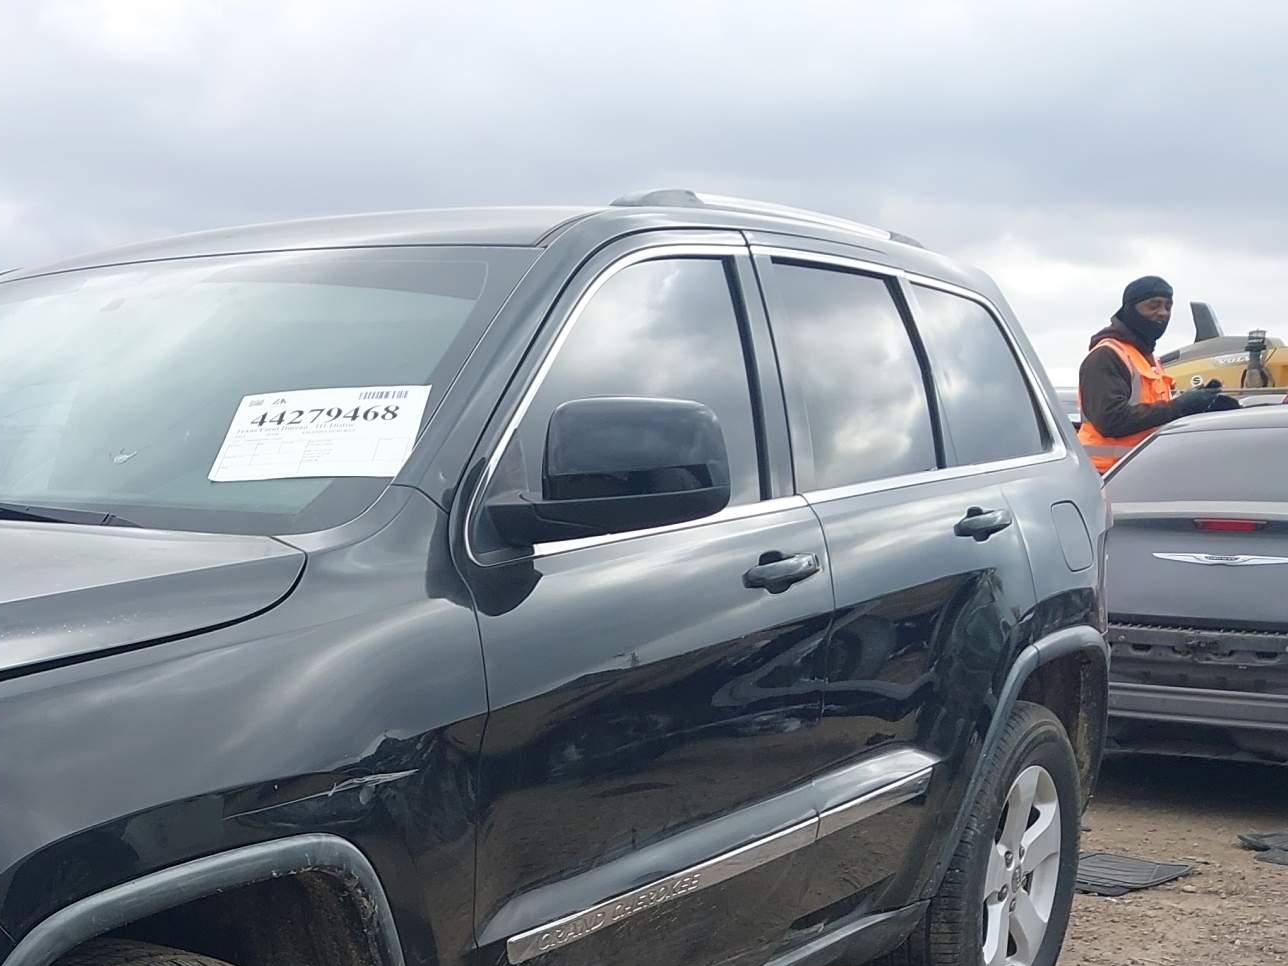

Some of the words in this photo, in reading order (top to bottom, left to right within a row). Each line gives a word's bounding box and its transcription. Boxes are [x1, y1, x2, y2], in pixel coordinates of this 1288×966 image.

[251, 405, 400, 427] 44279468
[539, 911, 607, 951] GRAND
[612, 872, 702, 922] CHEROKEE
